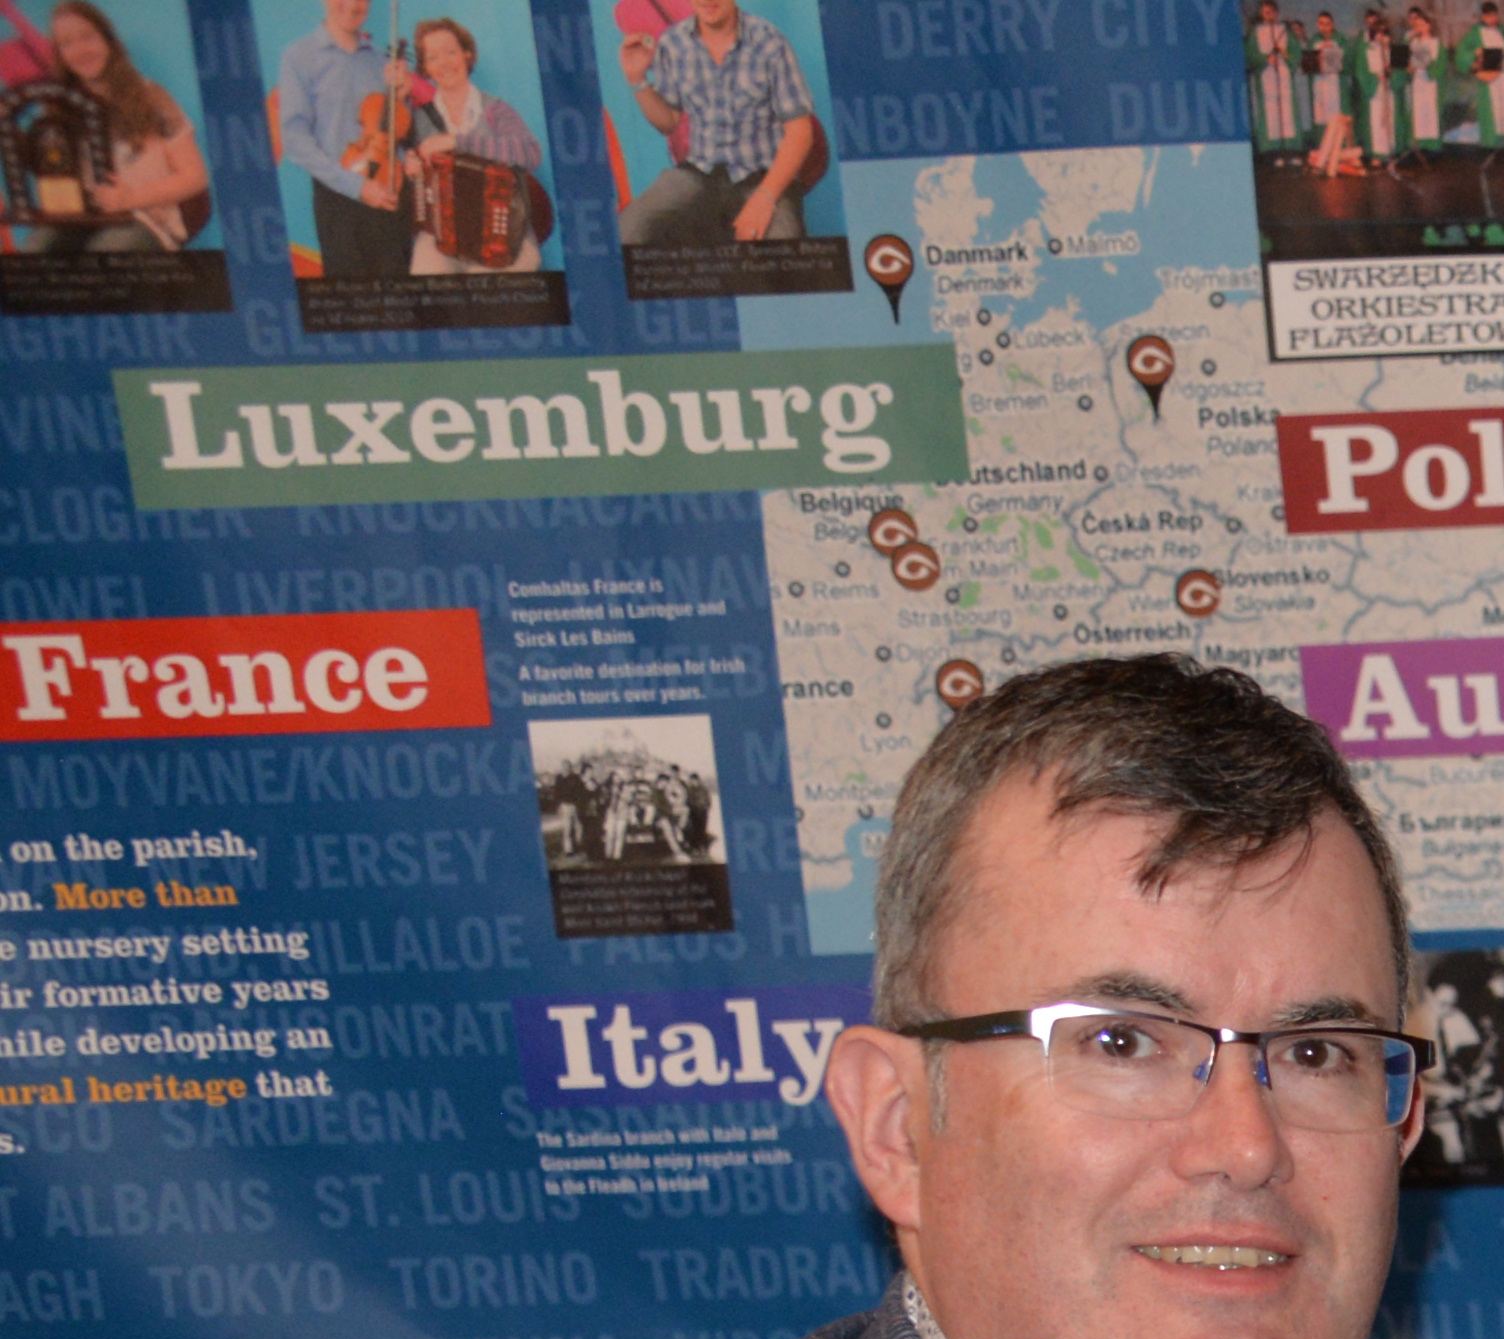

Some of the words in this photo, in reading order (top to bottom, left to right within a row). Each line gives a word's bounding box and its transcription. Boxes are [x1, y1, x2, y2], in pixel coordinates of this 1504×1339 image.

[926, 243, 1030, 265] Danmark
[937, 274, 1024, 295] Denmark
[149, 369, 893, 474] Luxemburg
[1199, 405, 1282, 429] Polska
[1158, 510, 1204, 535] Rep
[507, 580, 591, 598] Comhaltas
[593, 578, 646, 596] France
[650, 577, 664, 593] is
[511, 602, 604, 625] represented
[609, 602, 625, 620] in
[697, 599, 727, 616] and
[514, 630, 557, 648] Sirck
[560, 629, 589, 646] Les
[592, 628, 636, 645] Bains
[2, 633, 429, 721] France
[518, 665, 532, 681] A
[533, 662, 595, 680] favorite
[598, 659, 683, 679] destination
[684, 659, 707, 676] for
[709, 656, 746, 675] Irish
[521, 688, 578, 706] branch
[579, 689, 620, 704] tours
[623, 688, 656, 703] over
[660, 685, 707, 705] years.
[782, 678, 855, 699] rance
[10, 840, 58, 864] on
[63, 832, 125, 862] the
[130, 828, 259, 868] parish,
[291, 828, 496, 888] JERSEY
[52, 881, 147, 910] More
[155, 879, 241, 908] than
[27, 934, 171, 964] nursery
[181, 926, 311, 961] setting
[291, 915, 533, 975] KILLALOE
[43, 976, 224, 1009] formative
[231, 978, 331, 1010] years
[77, 1024, 278, 1060] developing
[286, 1026, 334, 1051] an
[547, 998, 845, 1106] Italy
[86, 1073, 248, 1107] heritage
[255, 1068, 334, 1099] that
[44, 1178, 279, 1238] ALBANS
[147, 1259, 344, 1318] TOKYO
[388, 1250, 598, 1311] TORINO
